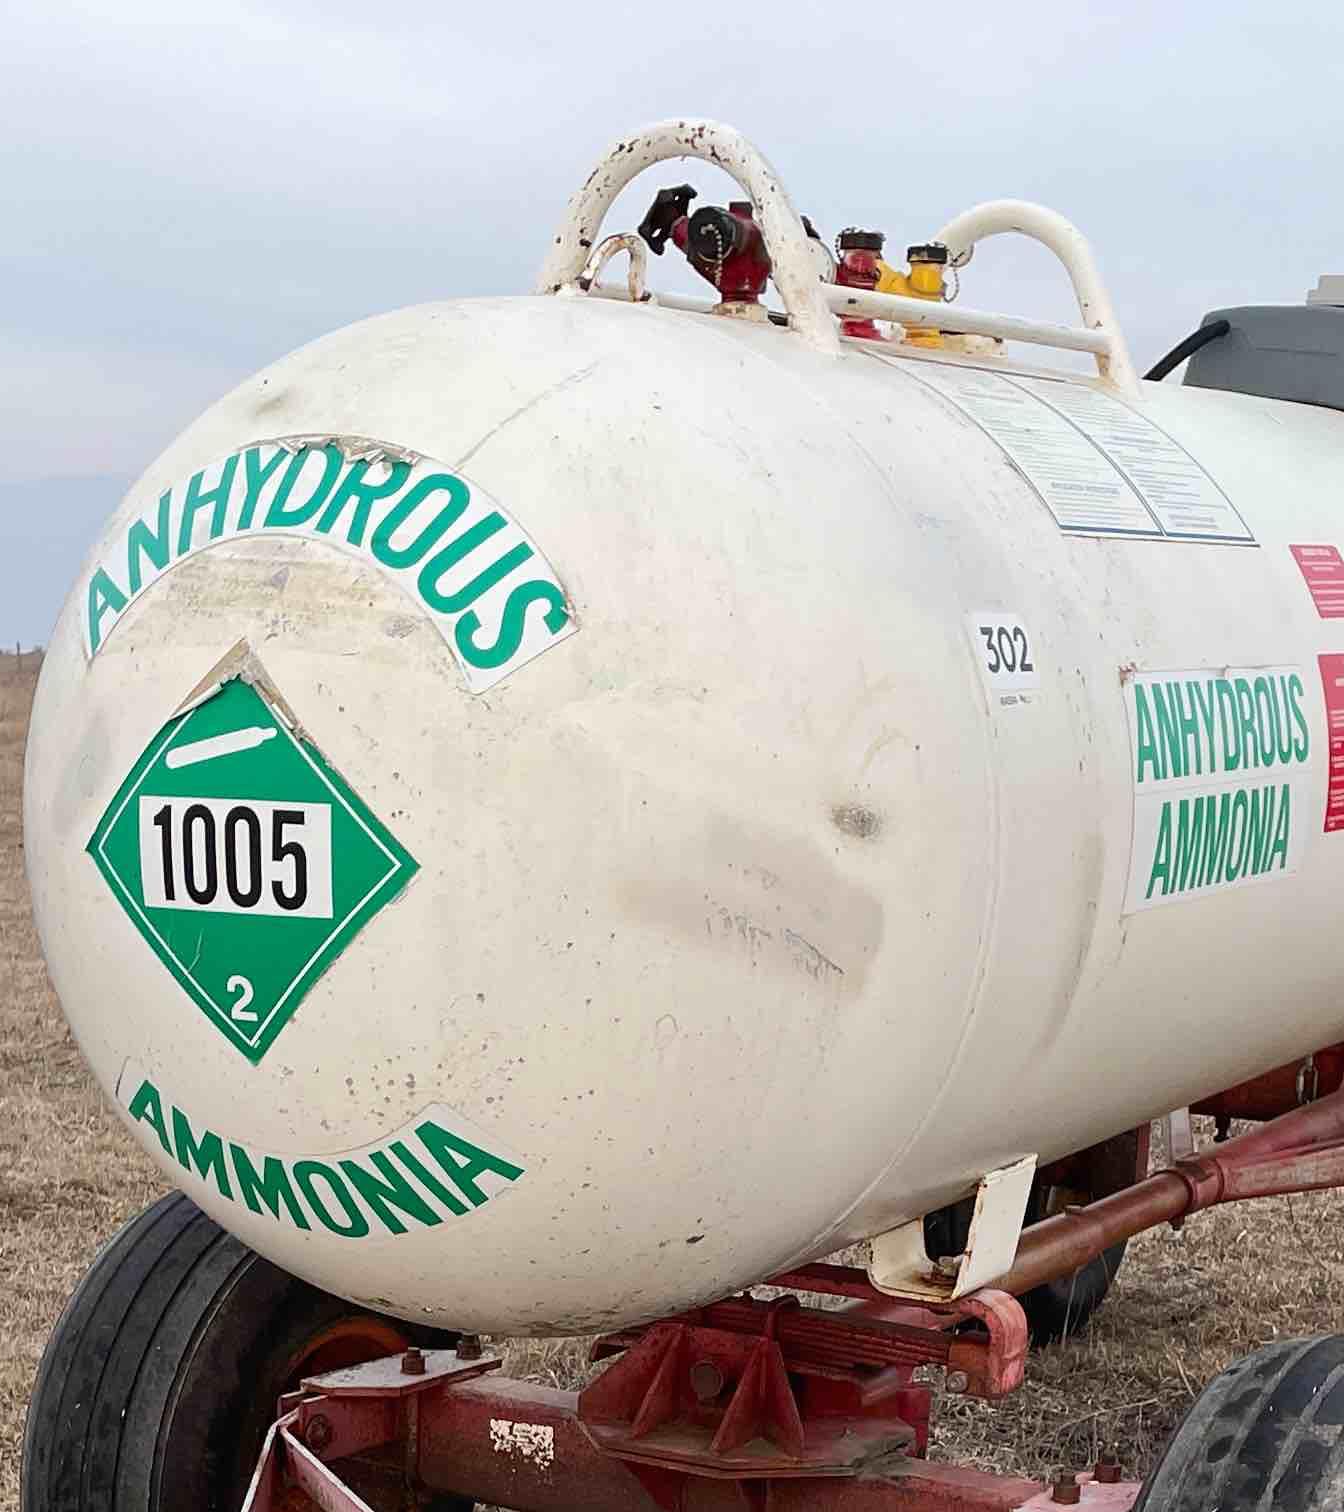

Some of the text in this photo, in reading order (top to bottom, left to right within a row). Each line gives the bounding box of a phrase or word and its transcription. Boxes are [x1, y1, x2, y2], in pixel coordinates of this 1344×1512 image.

[88, 440, 570, 670] ANHYDROUS
[979, 625, 1034, 674] 302
[1134, 672, 1310, 784] ANHYDROUS
[153, 803, 309, 911] 1005
[1144, 783, 1292, 900] AMMONIA
[225, 974, 259, 1022] 2
[127, 1078, 525, 1239] AMMONIA
